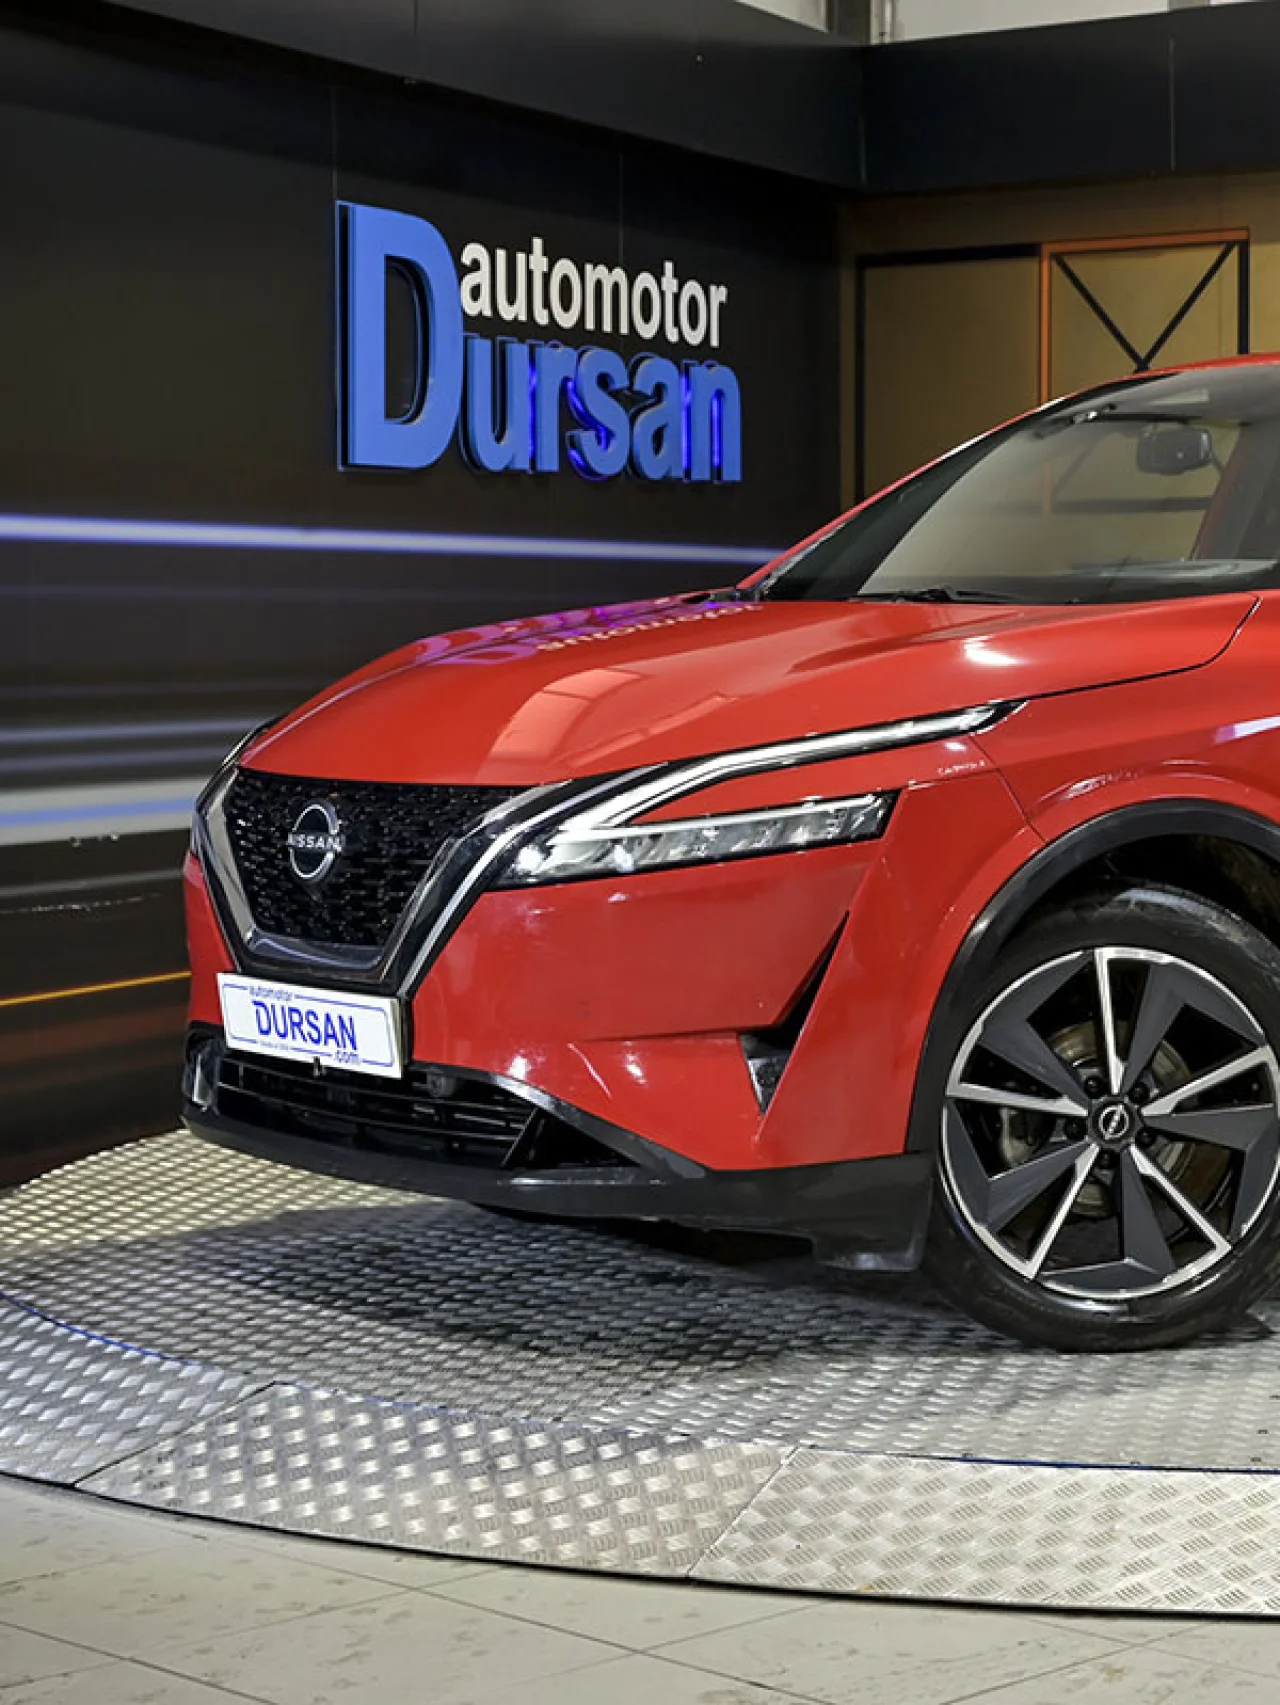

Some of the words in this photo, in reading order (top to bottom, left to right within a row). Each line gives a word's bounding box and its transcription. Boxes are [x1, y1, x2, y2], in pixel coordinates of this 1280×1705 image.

[336, 200, 743, 485] Dursan
[460, 237, 729, 348] automotor
[252, 1000, 357, 1050] DURSAN
